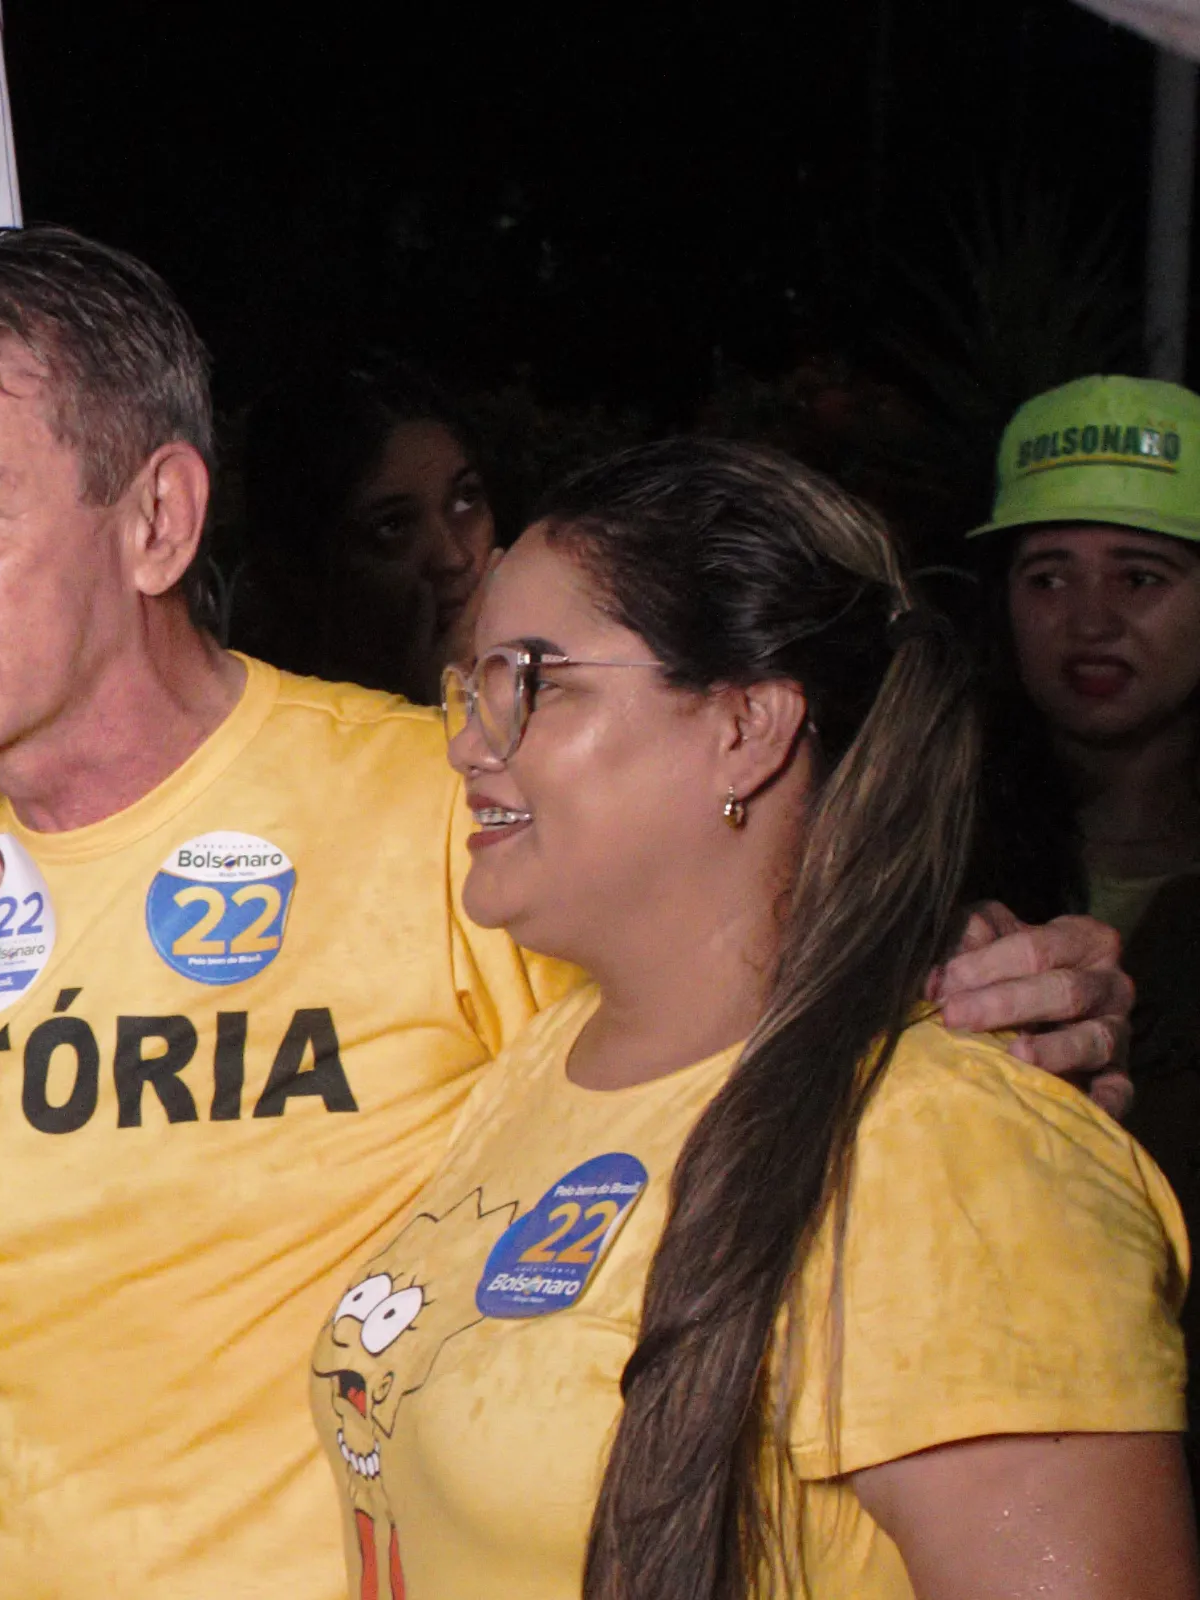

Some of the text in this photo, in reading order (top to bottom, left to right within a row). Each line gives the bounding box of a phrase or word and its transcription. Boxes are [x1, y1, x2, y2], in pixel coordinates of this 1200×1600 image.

[1018, 423, 1181, 469] BOLSONARO
[177, 850, 283, 870] Bolsonaro
[172, 884, 281, 955] 22
[517, 1200, 619, 1264] 22
[487, 1273, 581, 1296] Bolsonaro
